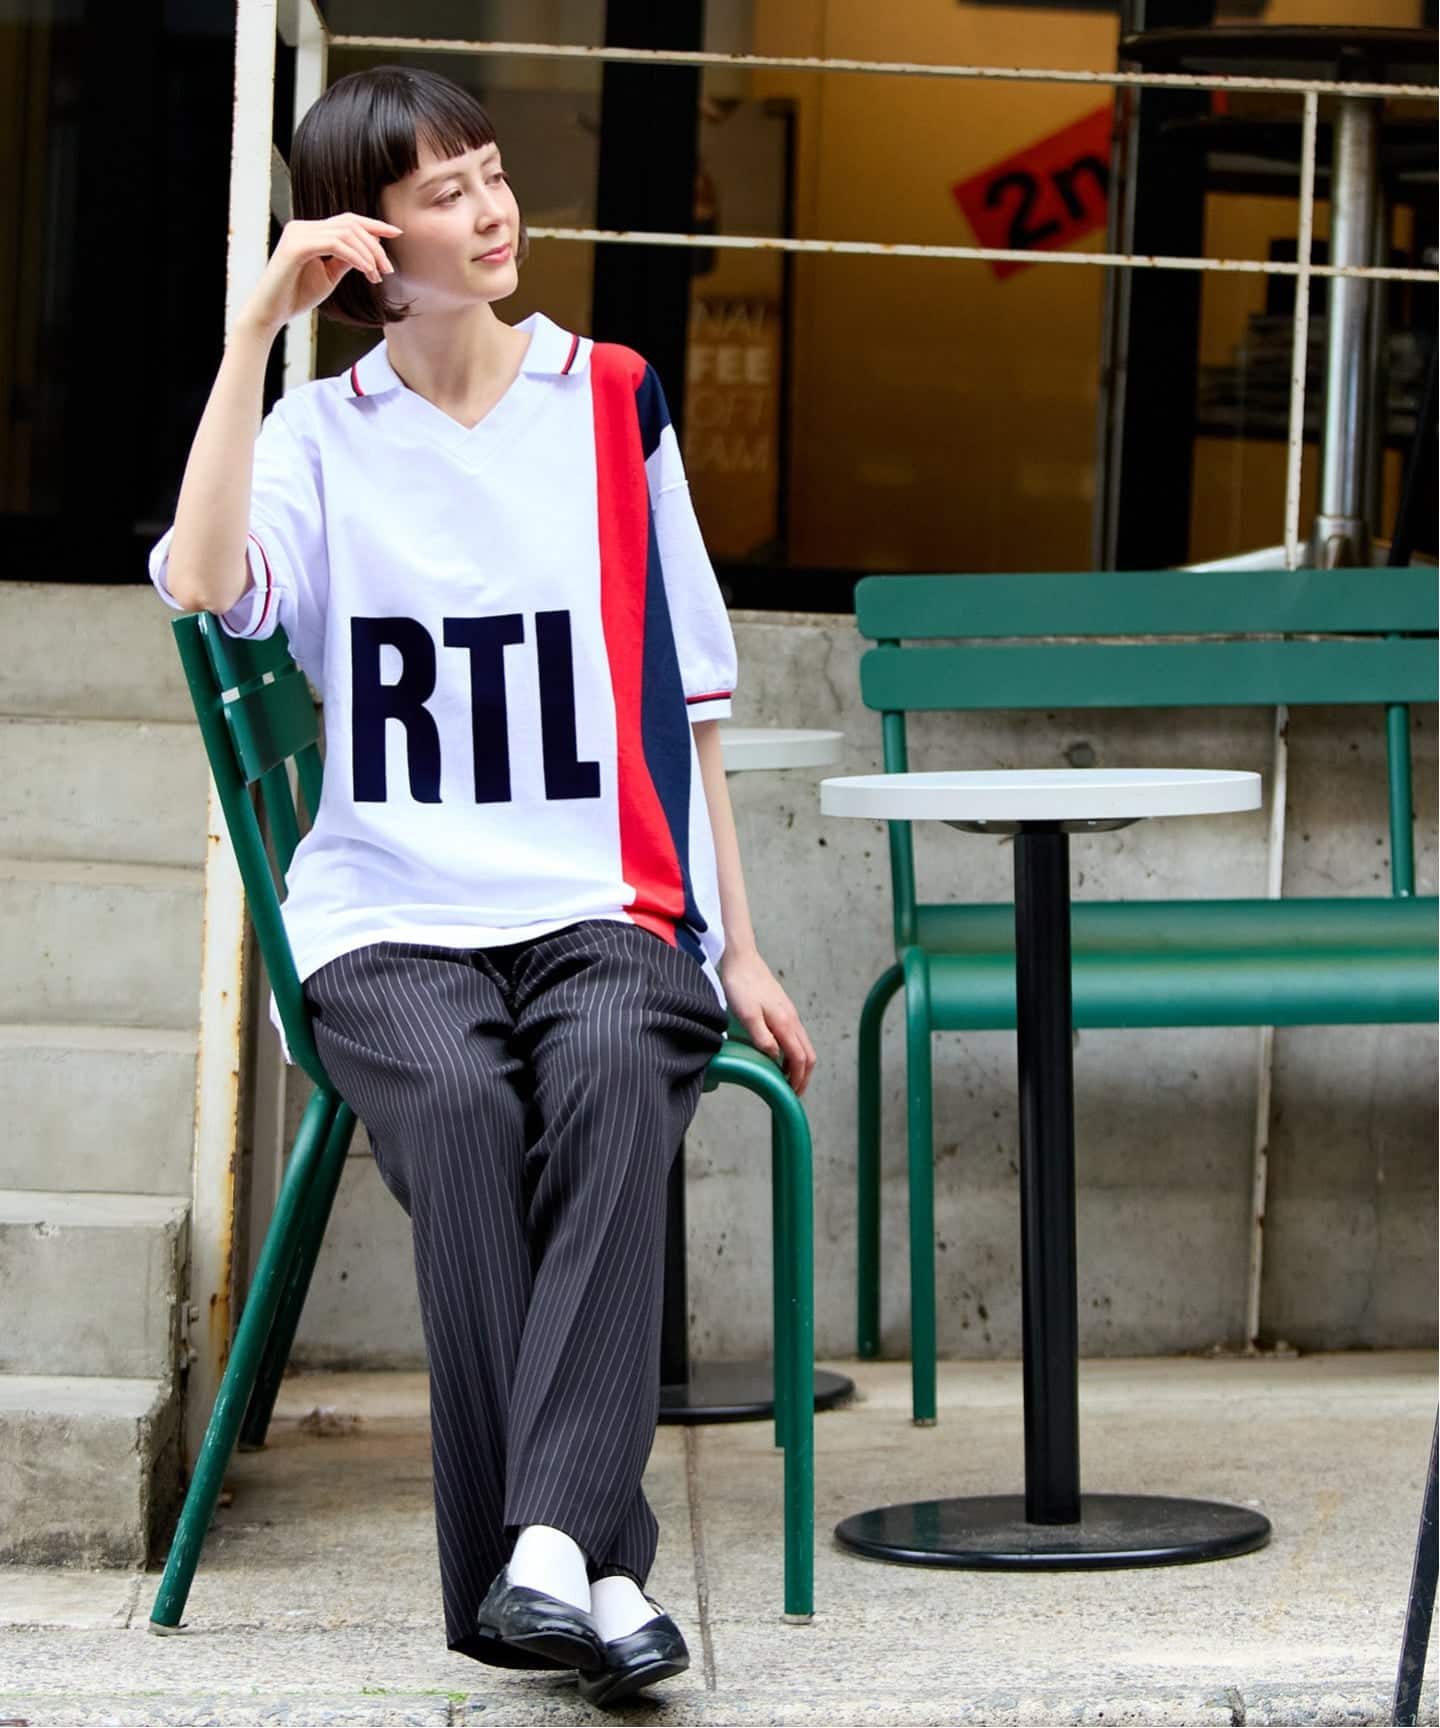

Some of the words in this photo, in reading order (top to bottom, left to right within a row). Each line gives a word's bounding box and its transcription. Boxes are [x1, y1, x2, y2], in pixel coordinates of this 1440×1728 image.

[986, 156, 1112, 250] 2n
[688, 346, 770, 385] FEE
[350, 610, 600, 804] RTL
